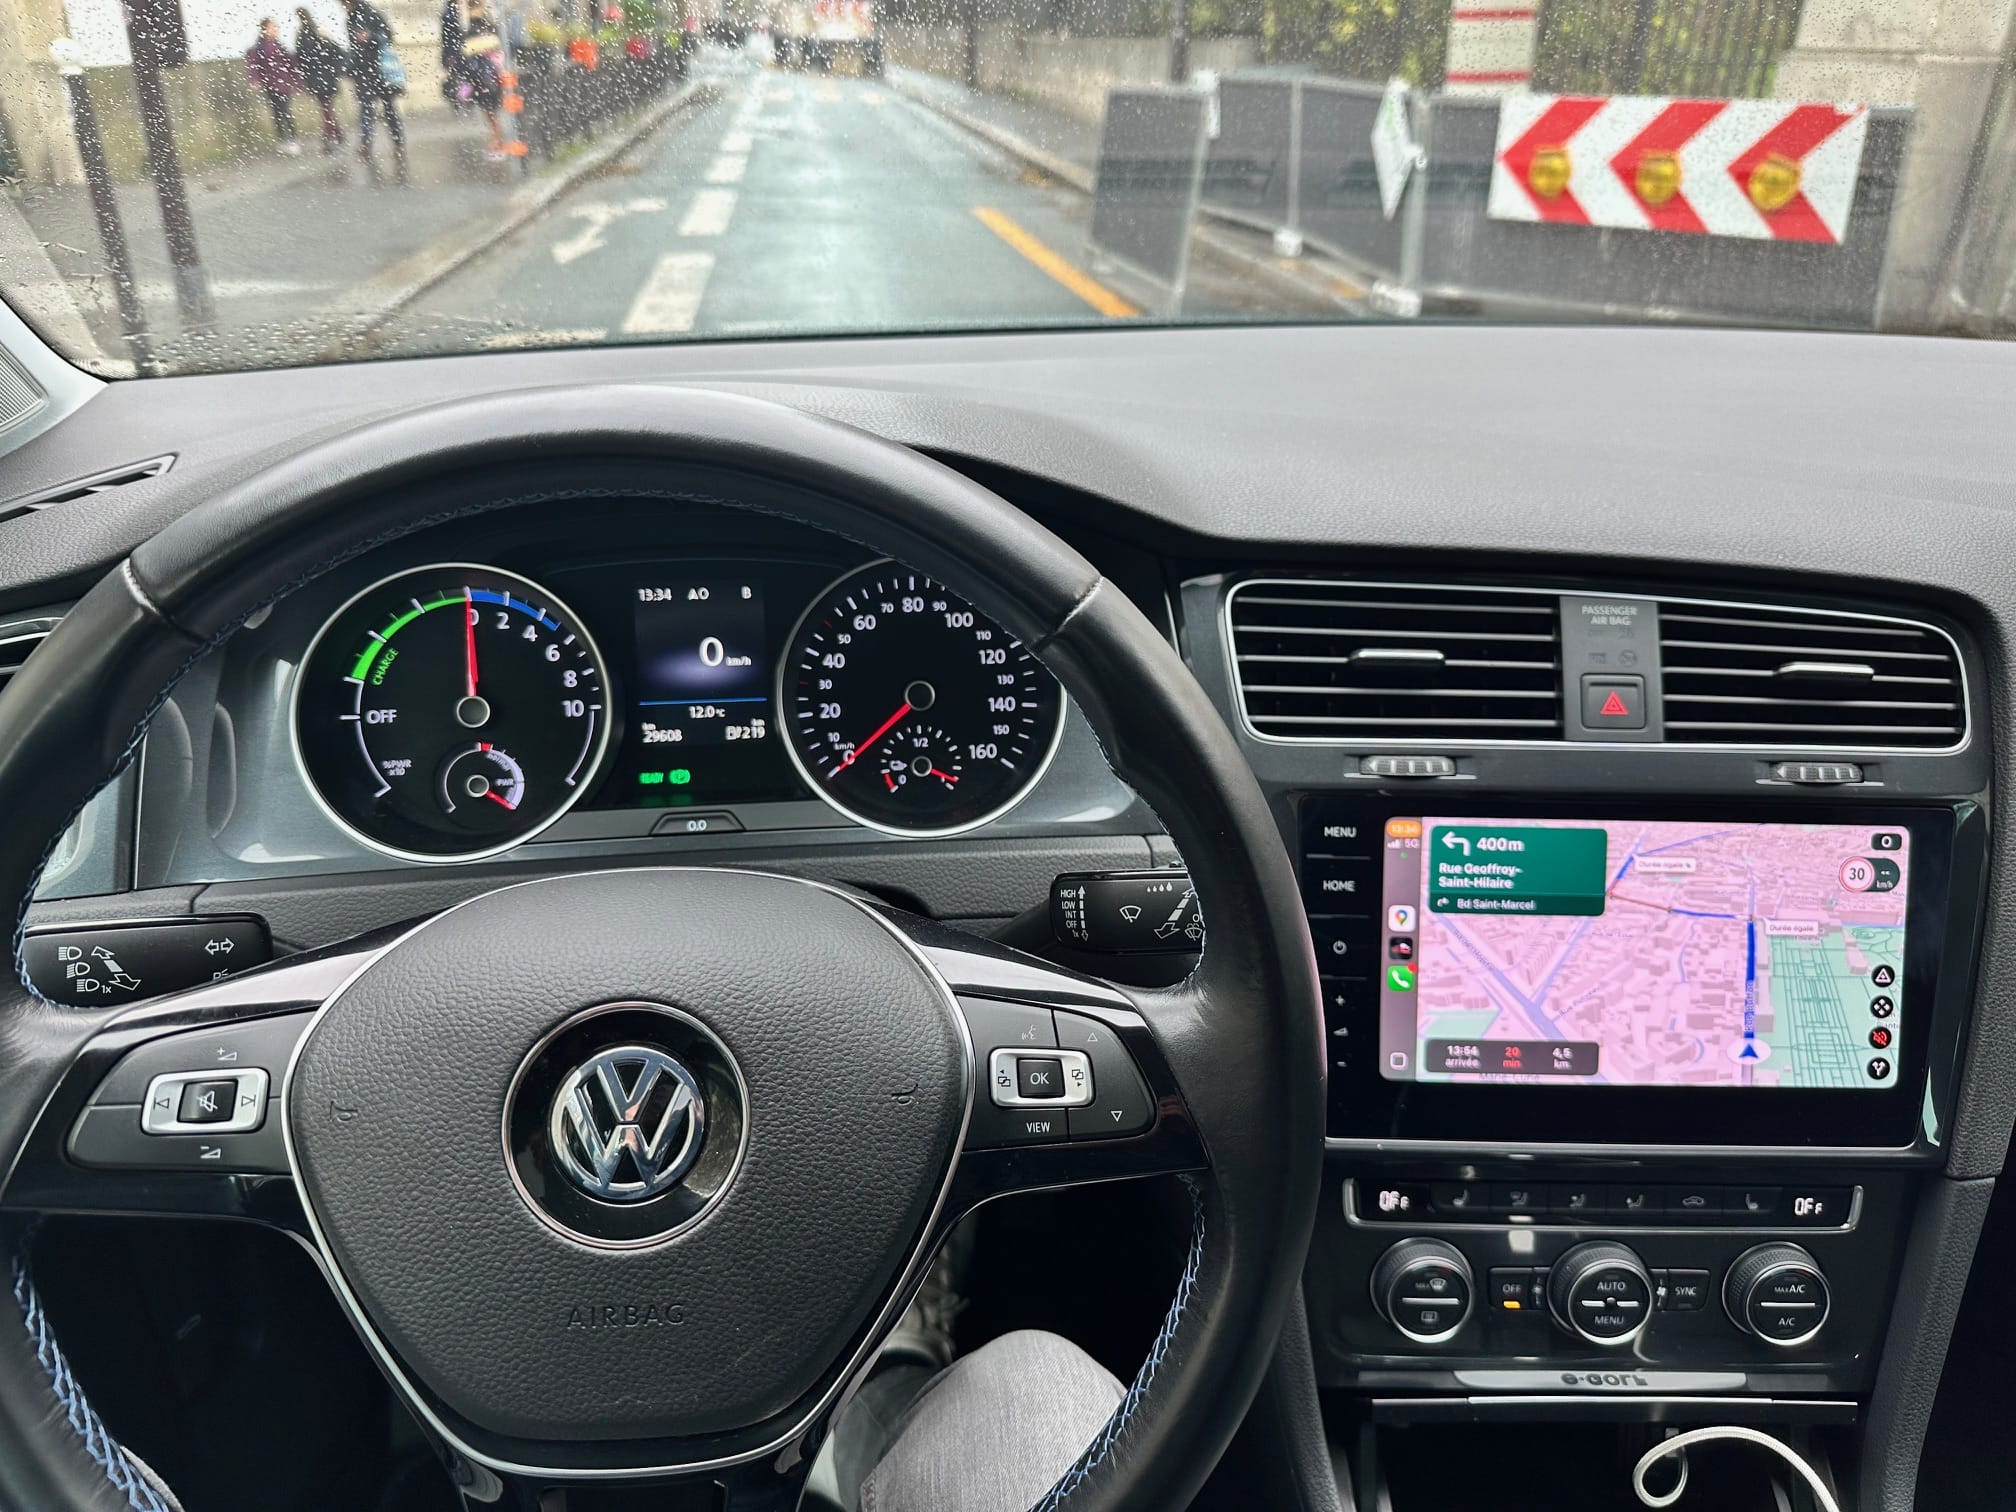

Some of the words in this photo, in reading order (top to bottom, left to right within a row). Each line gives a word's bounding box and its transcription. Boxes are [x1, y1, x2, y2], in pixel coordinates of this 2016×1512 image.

[638, 588, 672, 601] 13:34
[741, 586, 751, 599] B
[881, 602, 894, 613] 70
[902, 597, 924, 613] 80
[932, 601, 947, 611] 90
[1581, 605, 1637, 616] PASSENGER
[496, 612, 510, 629] 2
[853, 614, 877, 630] 60
[944, 612, 974, 628] 100
[1590, 615, 1608, 625] AIR
[1609, 616, 1632, 626] BAG
[522, 624, 537, 641] 4
[975, 630, 992, 641] 110
[836, 633, 851, 644] 50
[545, 645, 560, 662] 6
[699, 636, 723, 667] 0
[726, 656, 752, 666] km/h
[979, 648, 1006, 665] 120
[822, 652, 846, 669] 40
[371, 648, 399, 686] CHARGE
[563, 670, 577, 688] 8
[818, 678, 833, 690] 30
[996, 674, 1015, 685] 130
[562, 700, 584, 717] 10
[988, 696, 1016, 712] 140
[819, 702, 841, 719] 20
[366, 709, 398, 724] OFF
[742, 726, 765, 739] 219
[992, 724, 1010, 735] 150
[643, 729, 683, 743] 29608
[827, 732, 840, 743] 10
[833, 742, 855, 751] km/h
[912, 737, 929, 748] 1/2
[968, 743, 998, 759] 160
[843, 749, 855, 765] 0
[898, 774, 907, 785] 0
[687, 820, 707, 831] 0.0
[1324, 826, 1357, 838] MENU
[1438, 863, 1462, 874] Rue
[1849, 868, 1865, 880] 30
[1323, 880, 1356, 892] HOME
[1438, 876, 1514, 889] Saint-Hilaire
[1876, 880, 1893, 889] km/h
[1060, 889, 1076, 898] HIGH
[1061, 900, 1076, 910] LOW
[1457, 899, 1471, 909] Bd
[1473, 899, 1536, 911] Saint-Marcel
[1065, 911, 1076, 919] INT
[1066, 920, 1077, 929] OFF
[101, 984, 112, 994] 1x
[1447, 1046, 1479, 1057] 13:54
[1504, 1047, 1521, 1057] 20
[1445, 1057, 1480, 1069] arrivée
[1503, 1058, 1522, 1068] min
[1554, 1059, 1571, 1070] km
[1030, 1072, 1049, 1085] OK
[1026, 1122, 1051, 1134] VIEW
[1502, 1284, 1521, 1294] OFF
[1597, 1281, 1626, 1292] AUTO
[1675, 1286, 1697, 1296] SYNC
[1789, 1284, 1806, 1294] A/C
[567, 1304, 684, 1329] AIRBAG
[1594, 1316, 1624, 1326] MENU
[1778, 1317, 1796, 1327] A/C
